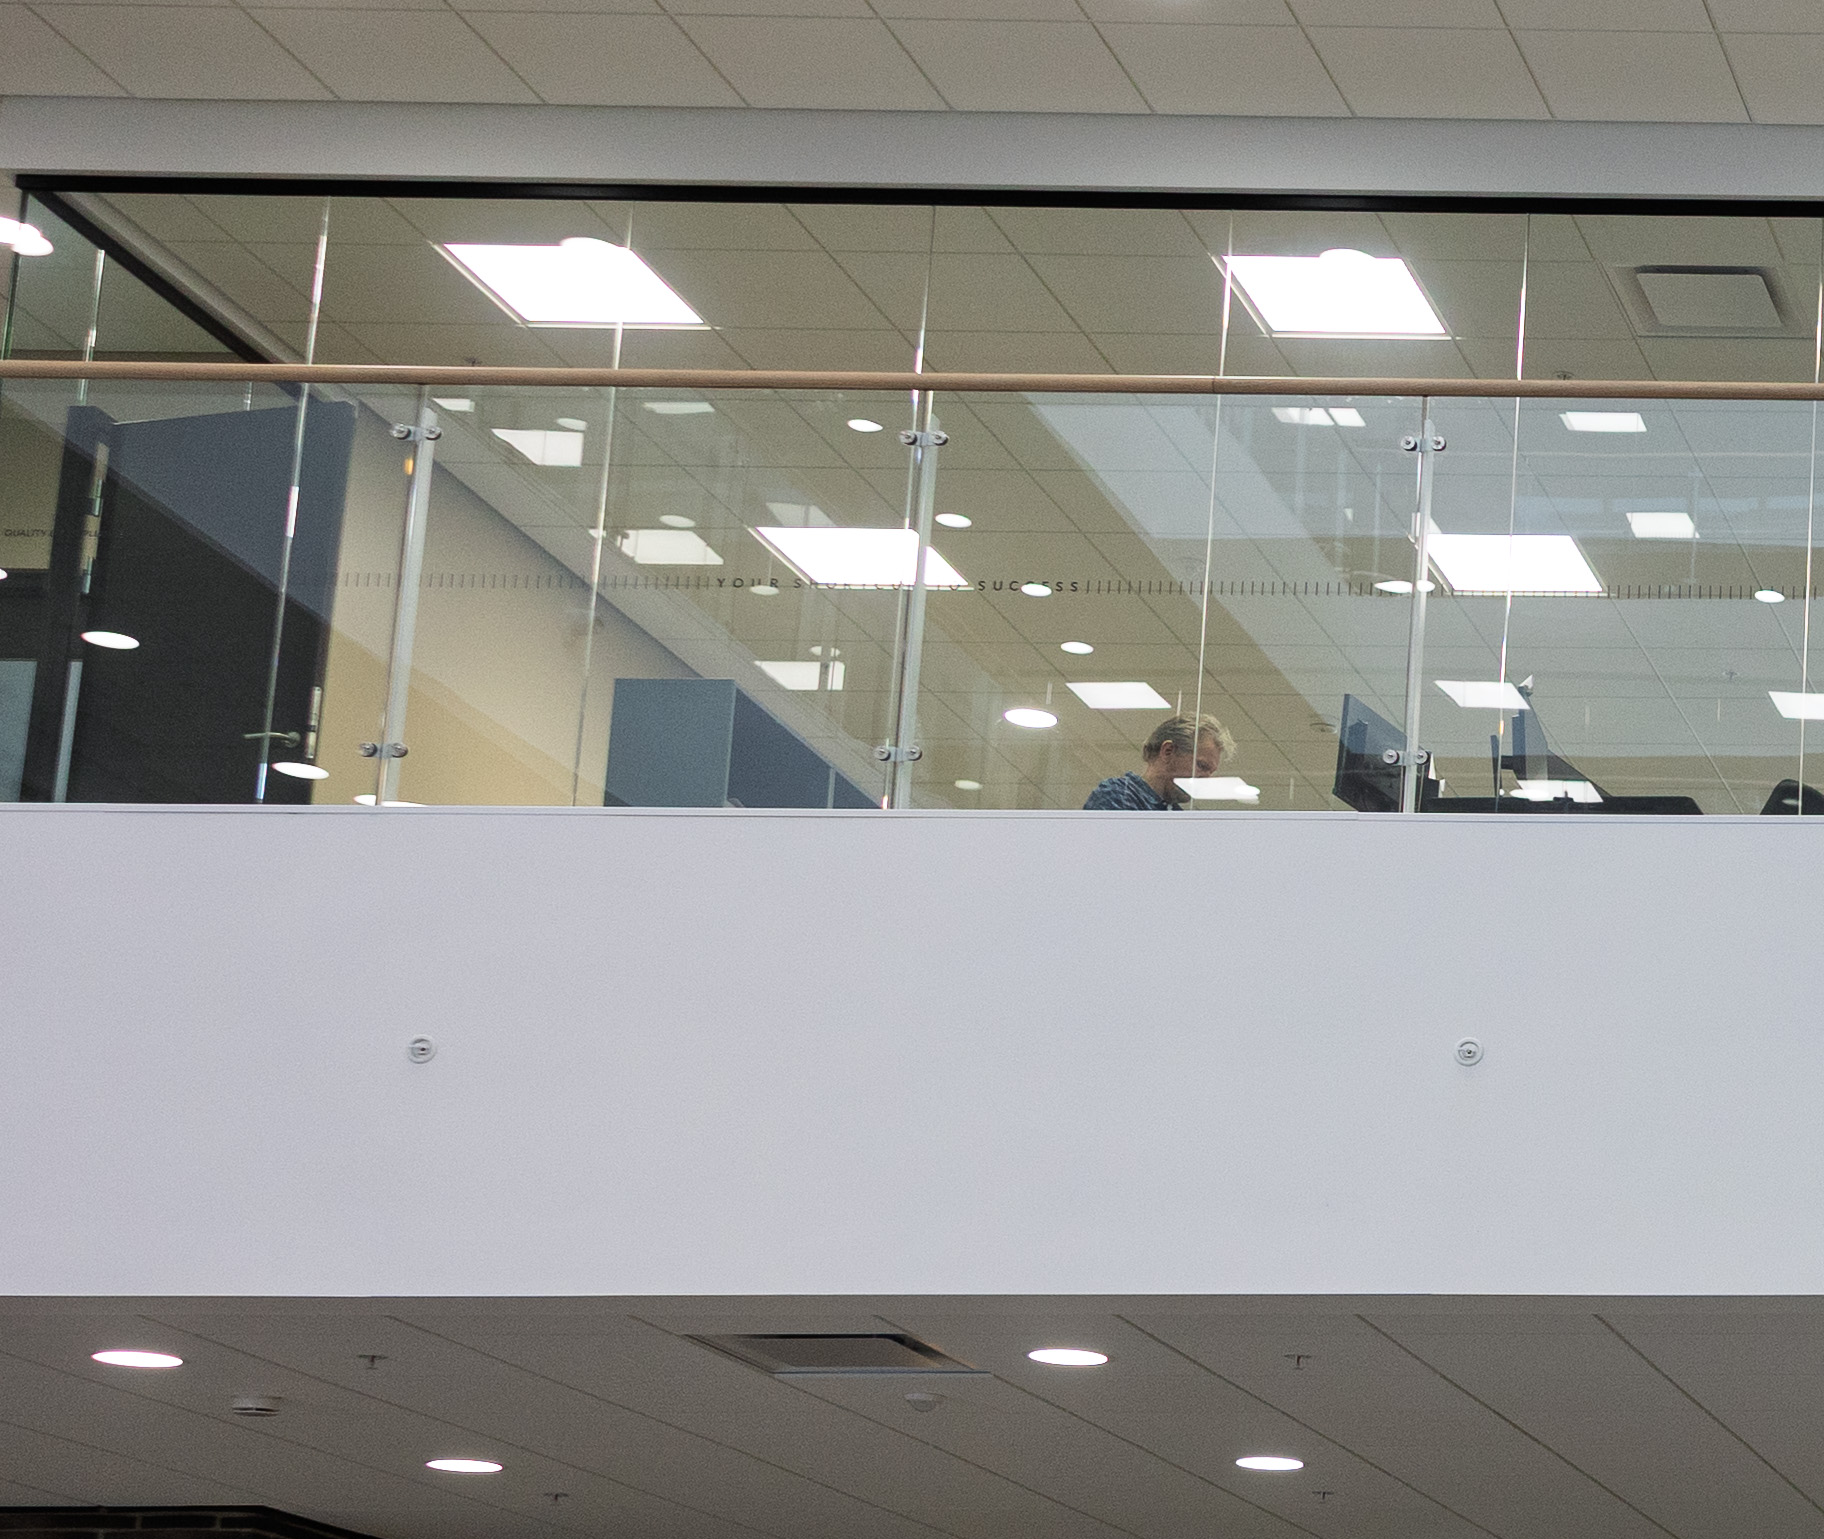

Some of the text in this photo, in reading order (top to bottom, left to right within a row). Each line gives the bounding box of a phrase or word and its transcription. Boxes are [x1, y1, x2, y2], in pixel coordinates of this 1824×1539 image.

[4, 529, 46, 538] QUALITY
[717, 578, 1079, 592] YOUR SUCSS
